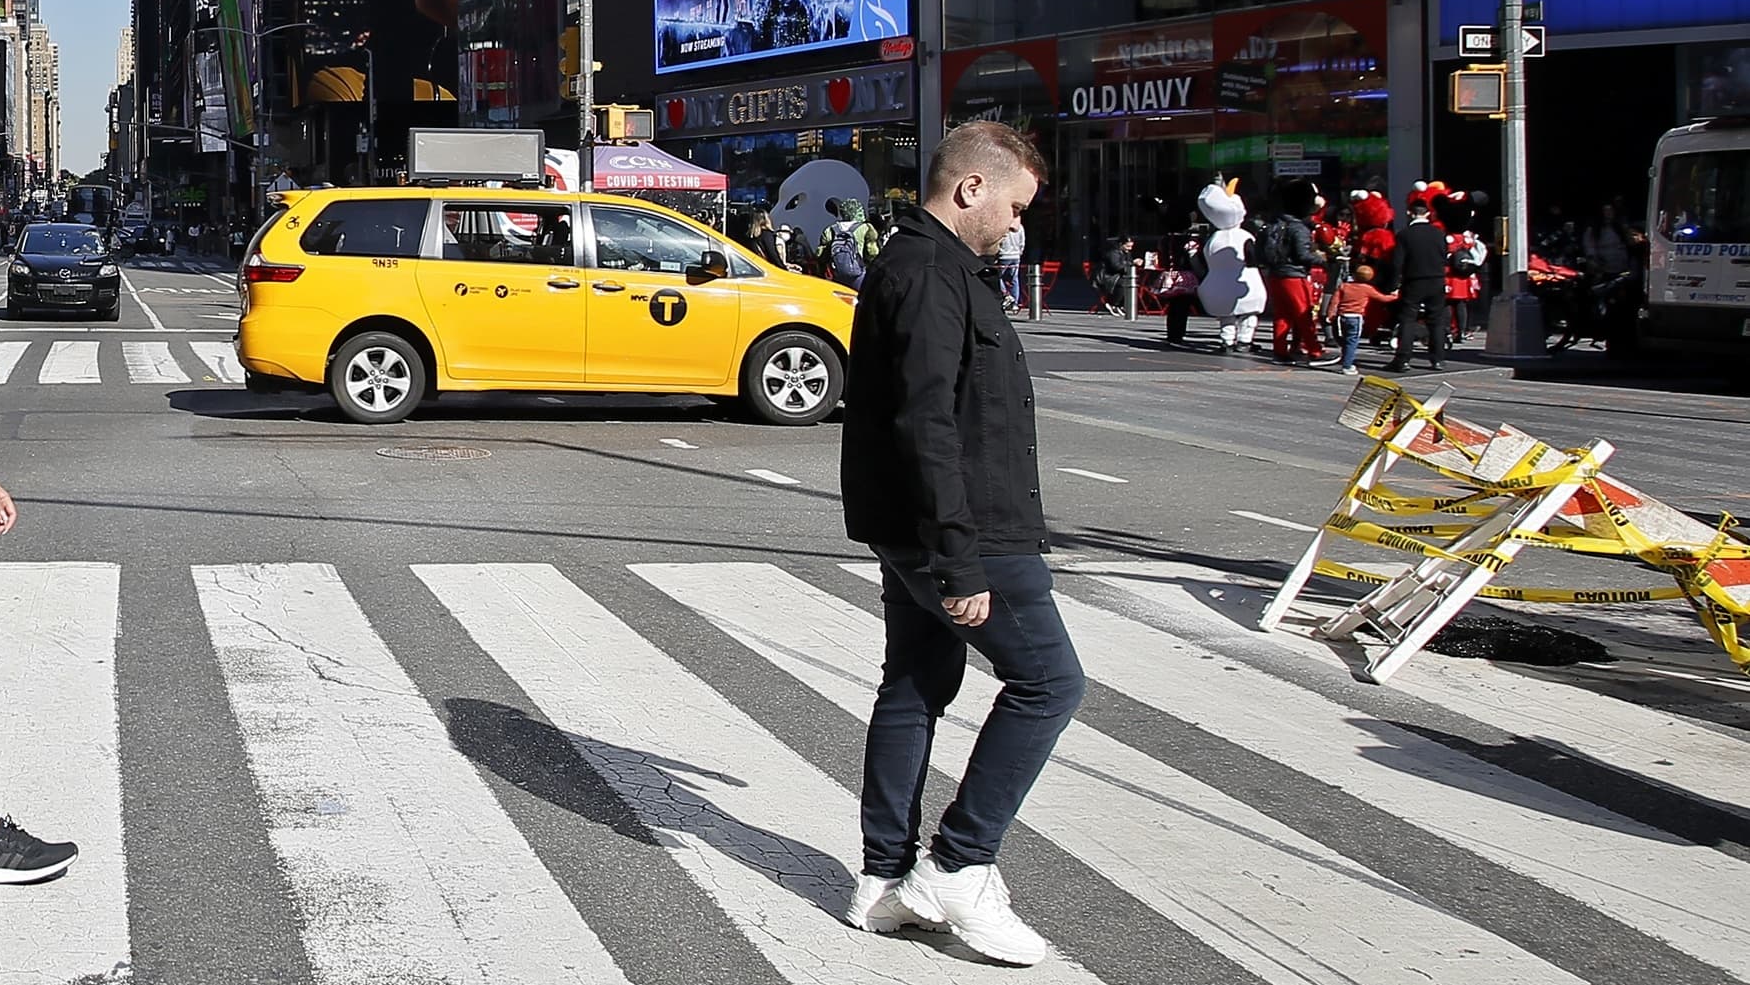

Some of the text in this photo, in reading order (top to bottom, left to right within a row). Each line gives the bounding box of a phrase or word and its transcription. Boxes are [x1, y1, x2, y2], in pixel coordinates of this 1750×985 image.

[680, 36, 725, 53] NOW STREAMING
[1072, 83, 1118, 115] OLD
[1123, 76, 1192, 113] NAVY
[728, 85, 808, 125] GIFTS
[606, 174, 701, 188] COVID-19 TESTING
[1674, 244, 1712, 256] NYPD
[630, 294, 649, 302] NYC
[658, 295, 680, 322] T
